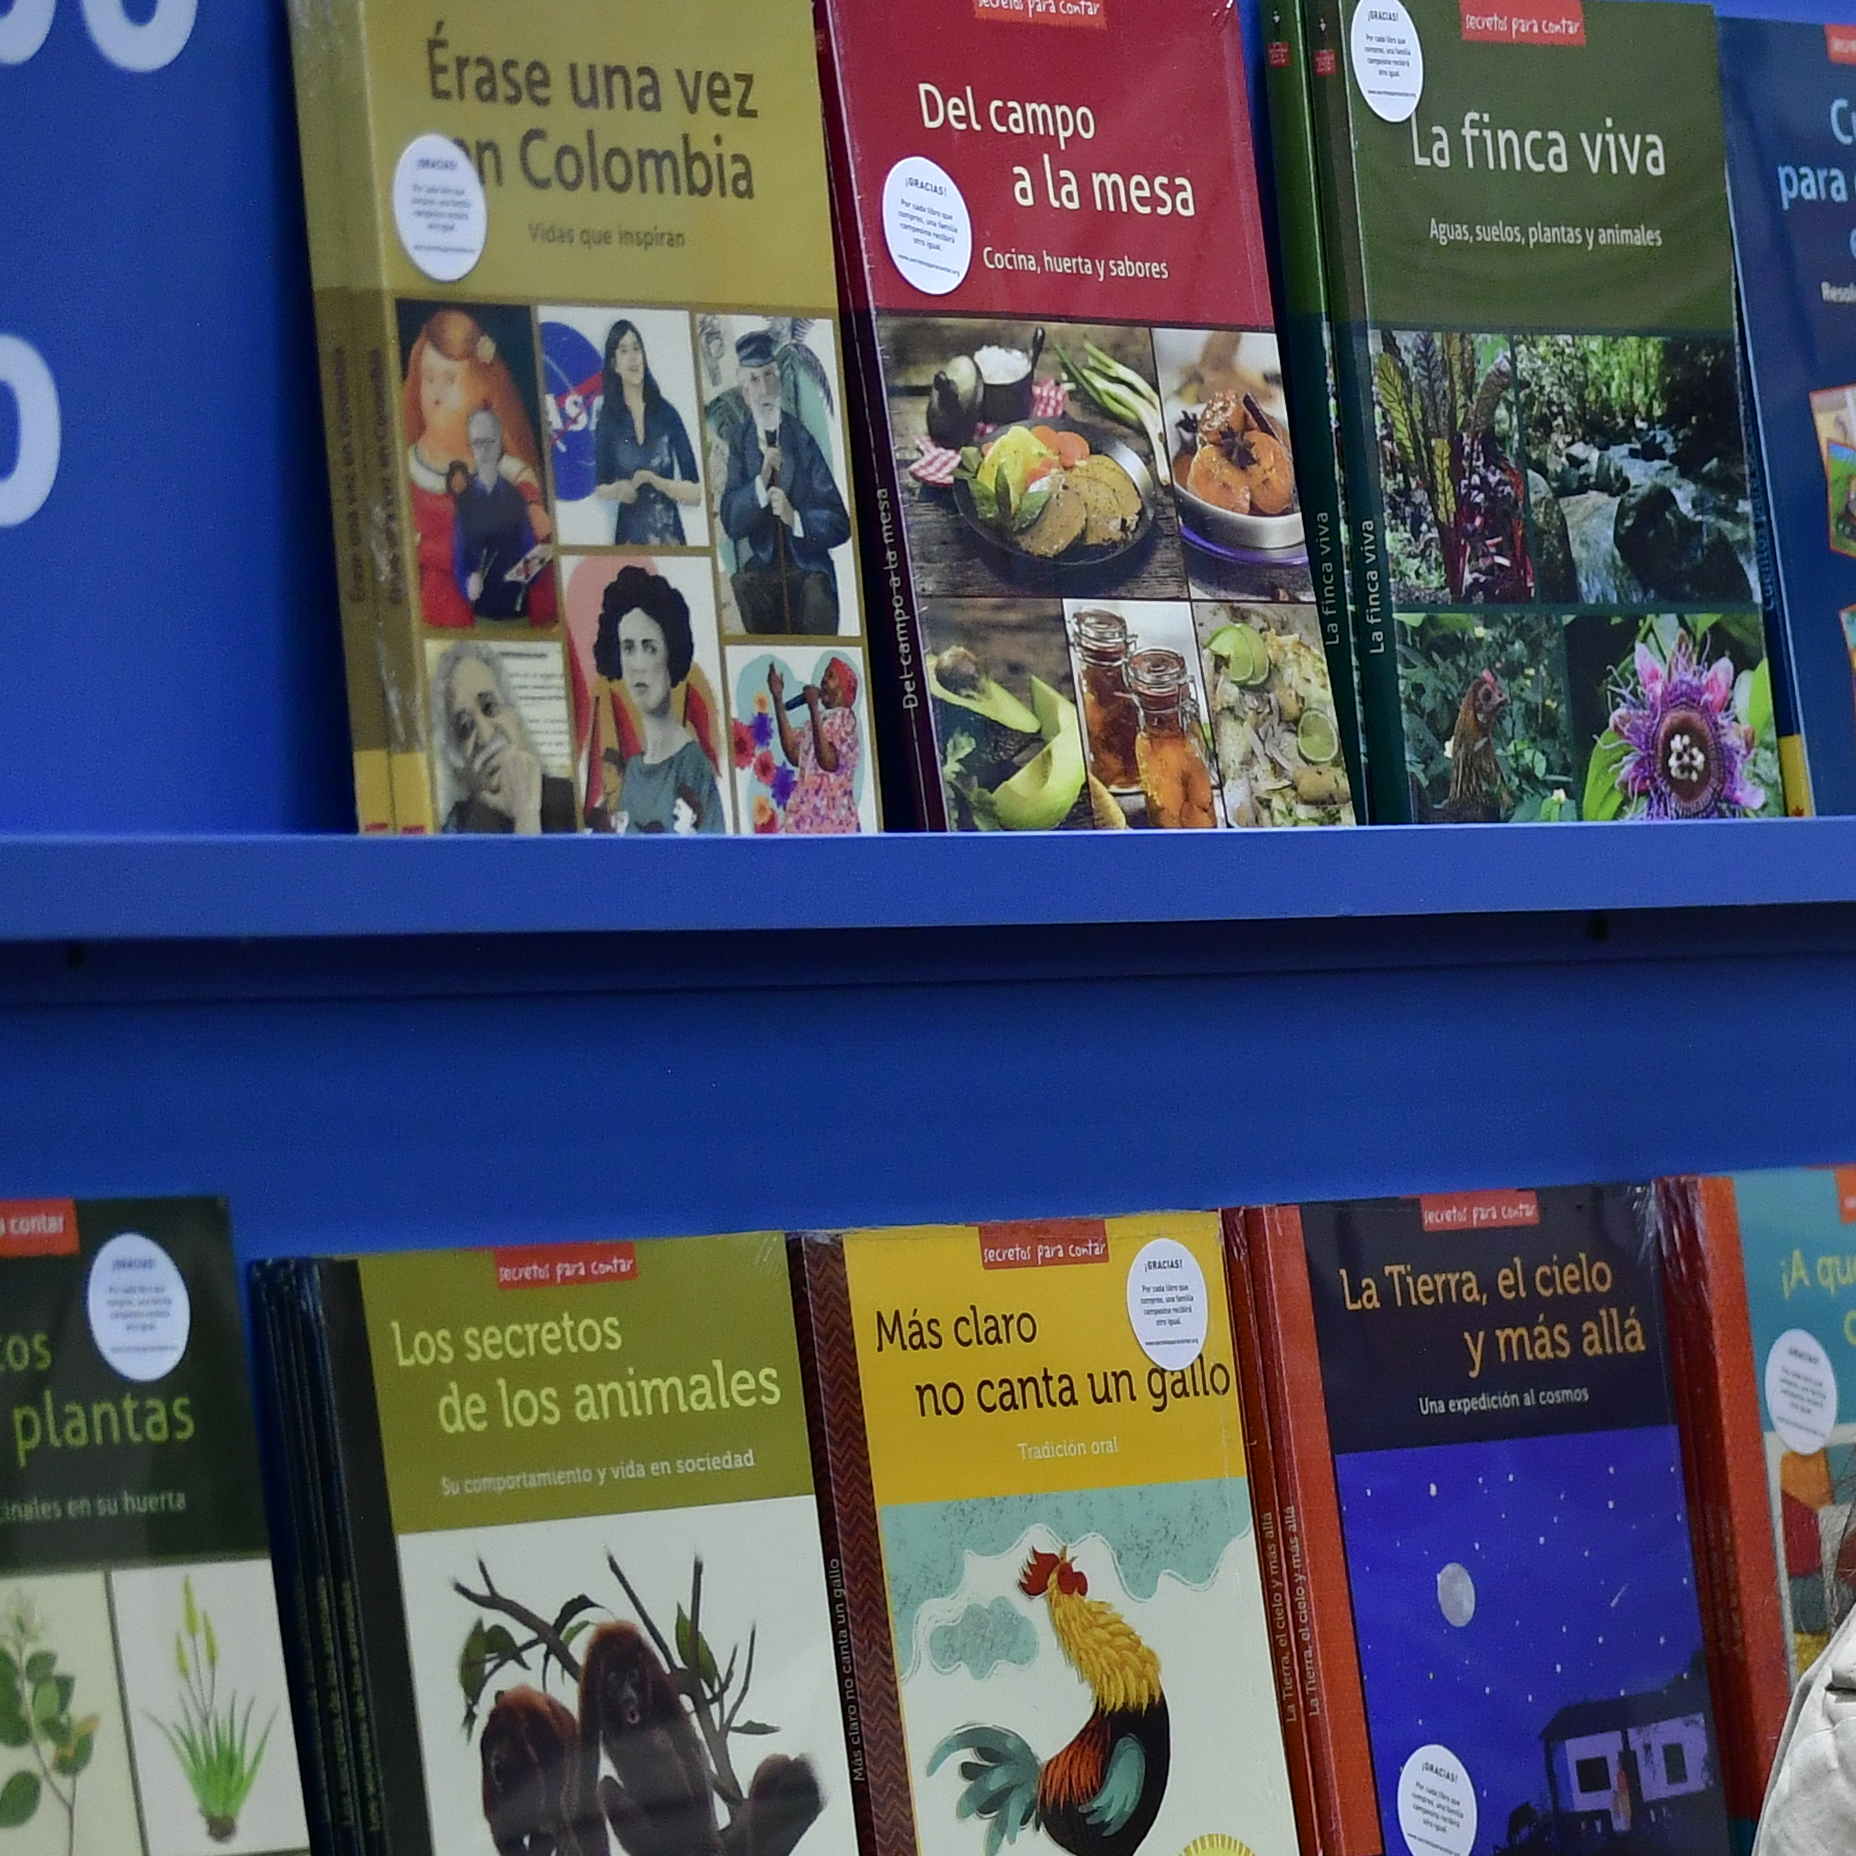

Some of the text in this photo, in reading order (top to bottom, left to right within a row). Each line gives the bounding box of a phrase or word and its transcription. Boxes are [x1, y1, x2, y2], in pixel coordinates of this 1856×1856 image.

[426, 20, 758, 118] Érase una vez
[917, 82, 1097, 150] Del campo
[1411, 111, 1666, 176] La finca viva
[519, 127, 755, 200] Colombia
[1012, 153, 1196, 217] a la mesa
[1777, 164, 1848, 211] para
[982, 246, 1169, 281] Cocina, huerta y sabores
[1429, 217, 1663, 251] Aguas, suelos, plantas y animales
[984, 1241, 1106, 1265] secretos para contar
[1340, 1252, 1612, 1310] La Tierra, el cielo
[1782, 1247, 1811, 1300] ¡A
[391, 1312, 622, 1366] Los secretos
[875, 1305, 1037, 1352] Más claro
[1463, 1306, 1646, 1378] y más allá
[438, 1359, 782, 1434] de los animales
[916, 1354, 1231, 1417] no canta un gallo
[13, 1390, 195, 1467] plantas
